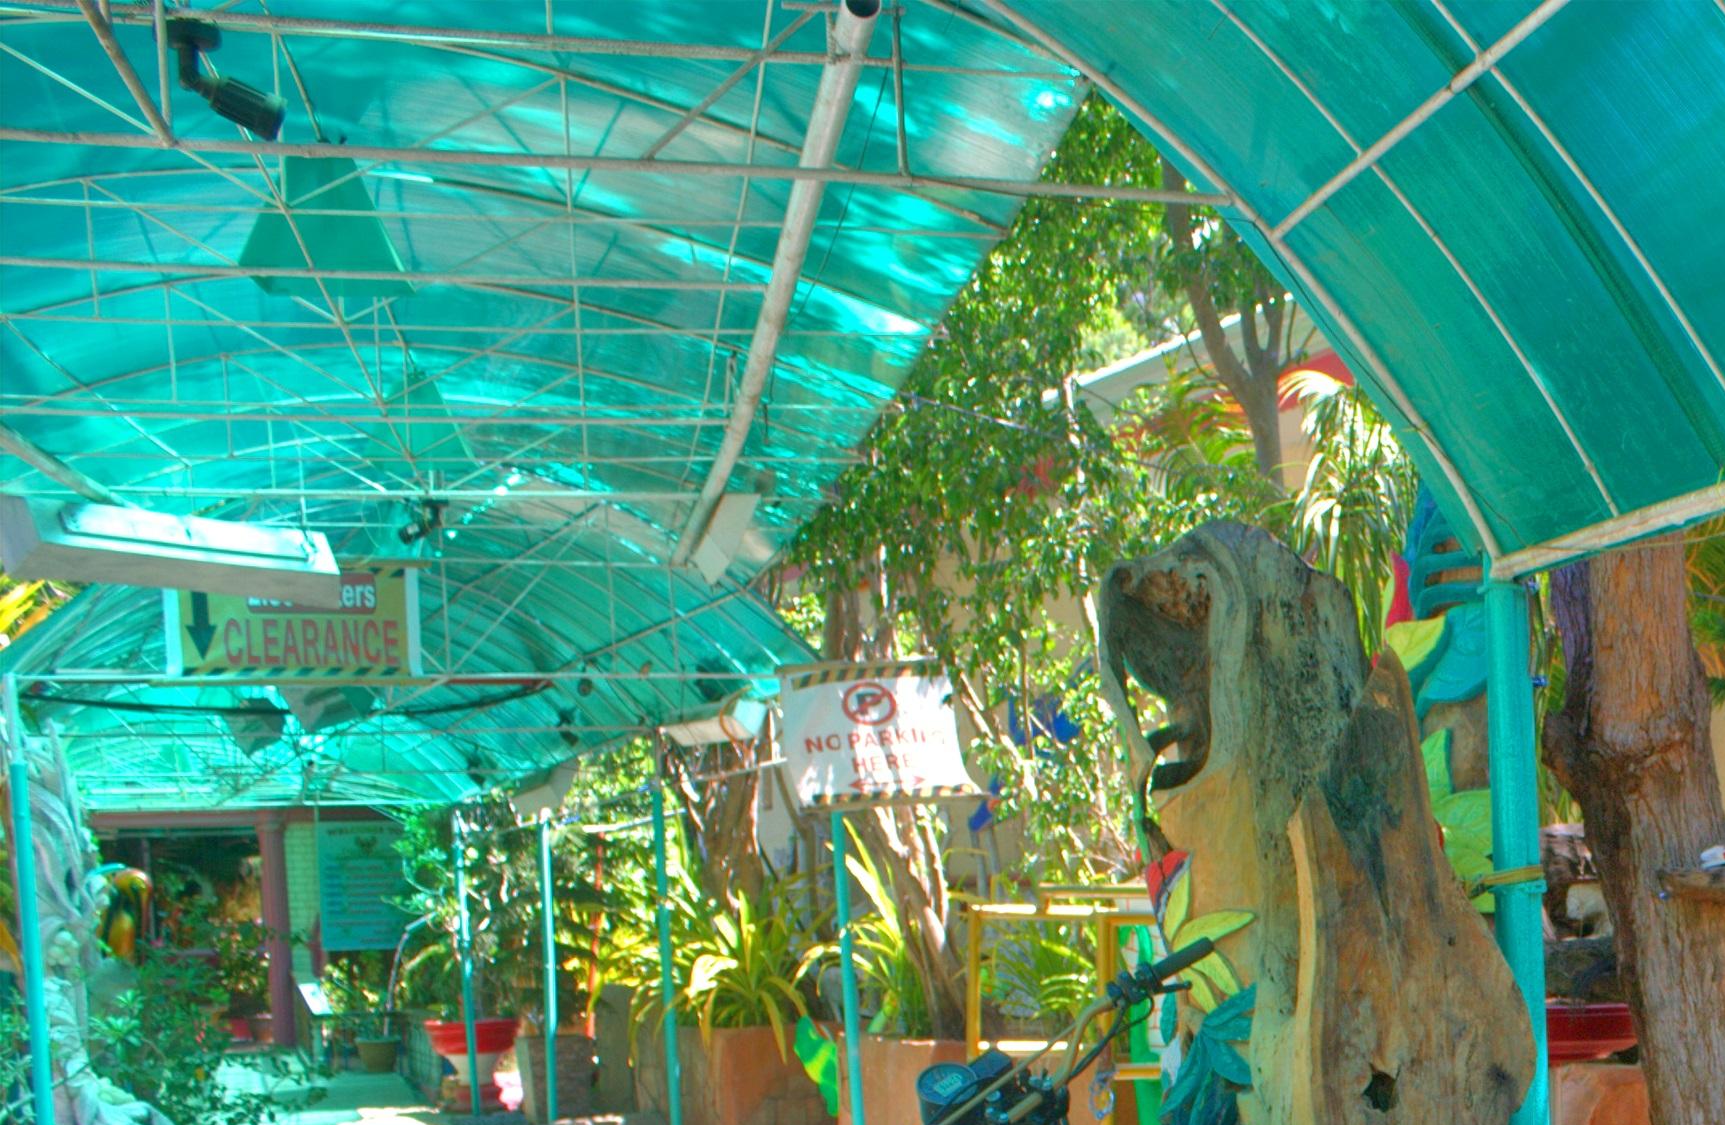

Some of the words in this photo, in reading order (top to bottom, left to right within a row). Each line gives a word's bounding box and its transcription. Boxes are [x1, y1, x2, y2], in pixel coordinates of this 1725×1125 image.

[224, 617, 399, 666] CLEARANCE
[805, 733, 841, 754] NO
[853, 753, 913, 773] HERE
